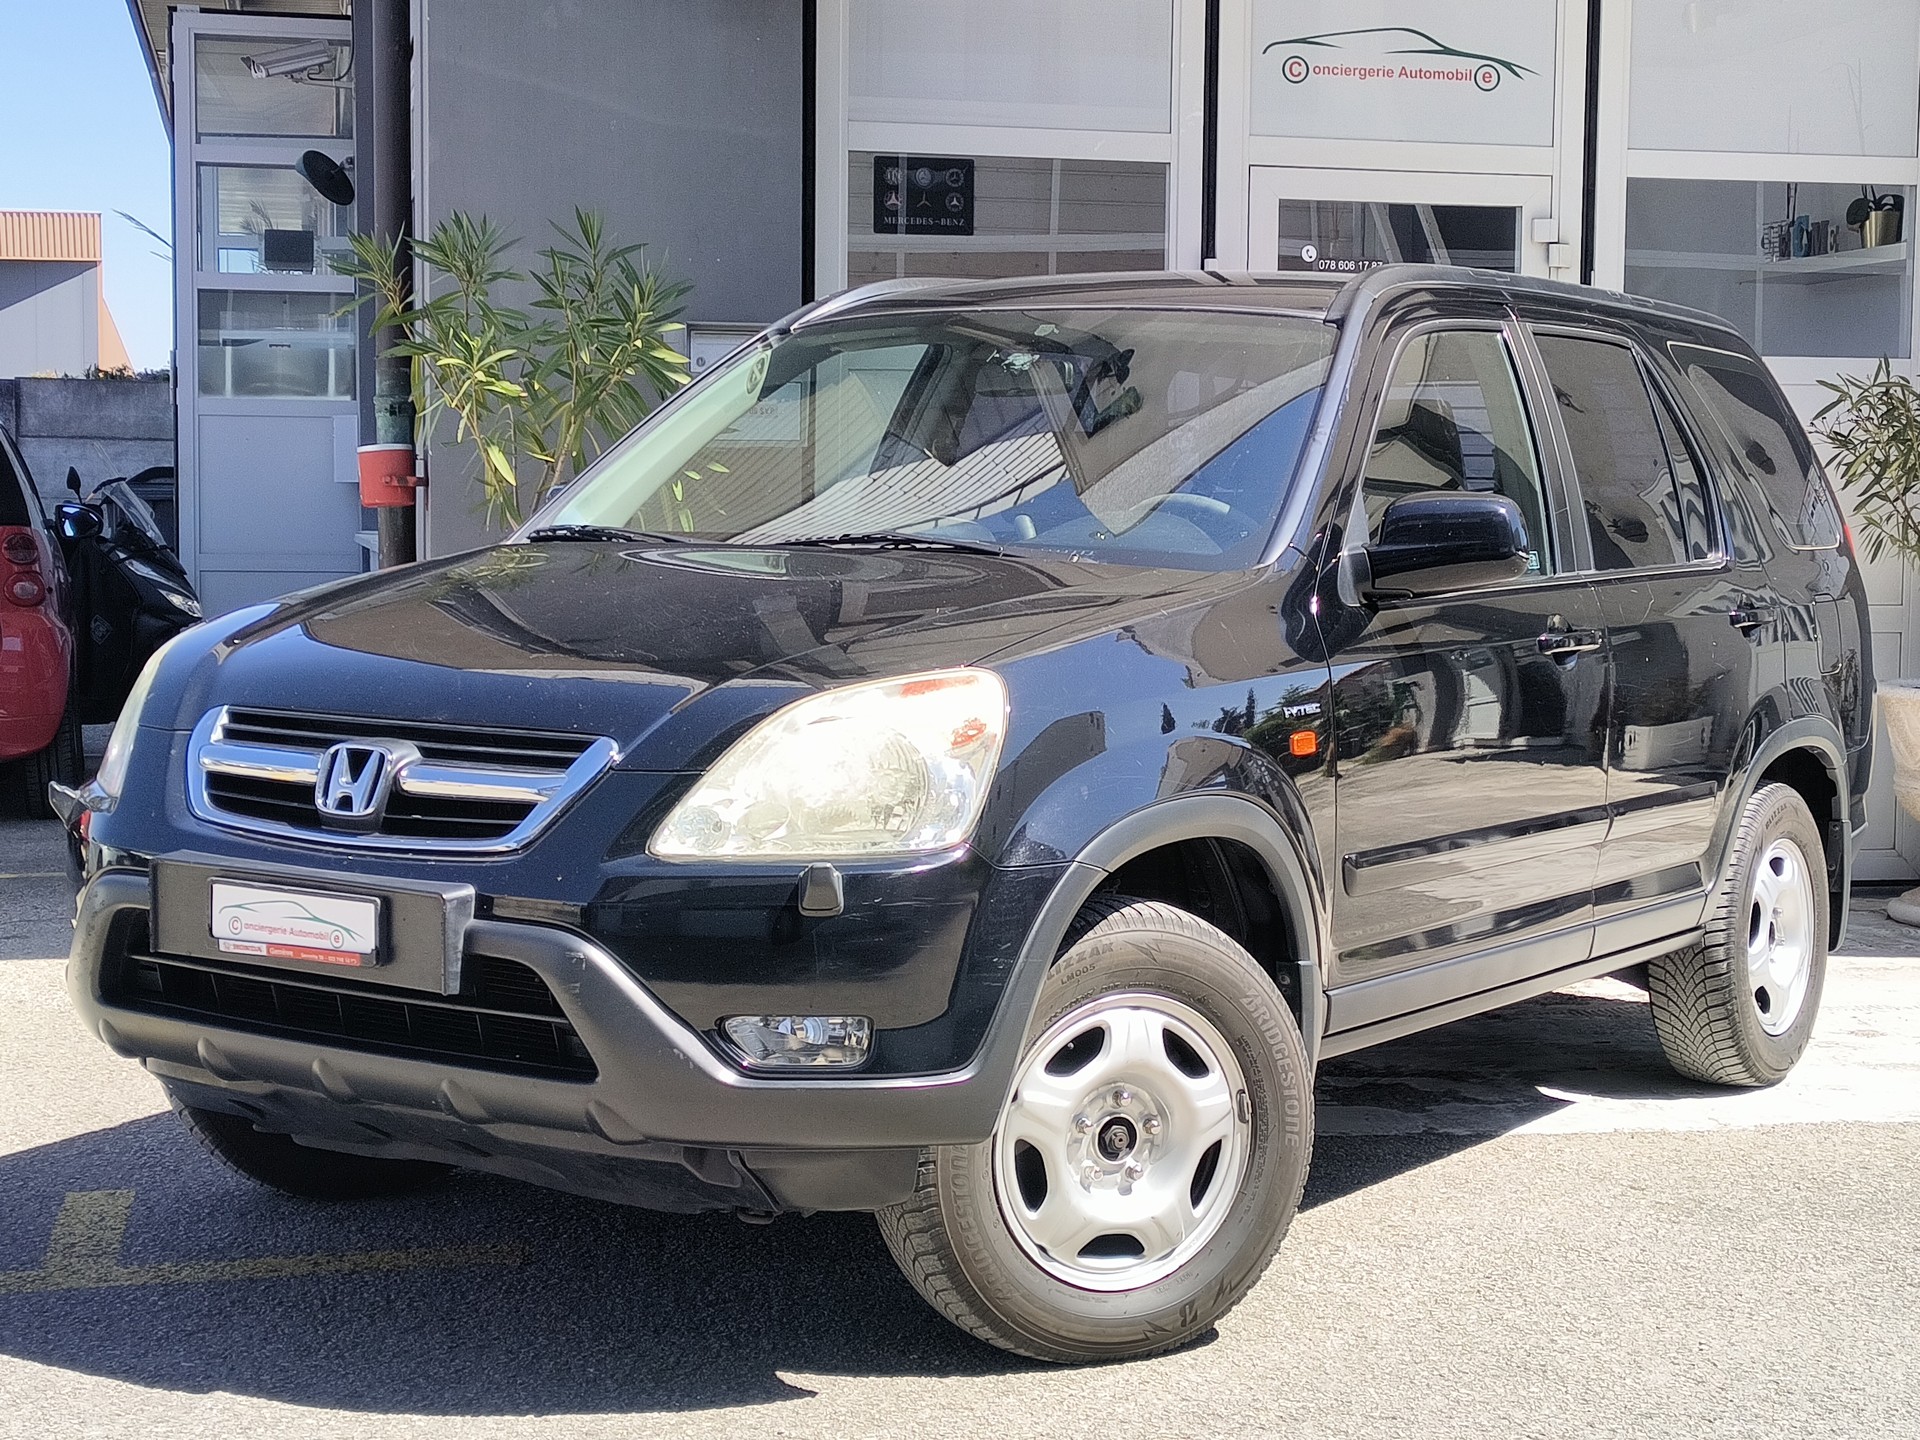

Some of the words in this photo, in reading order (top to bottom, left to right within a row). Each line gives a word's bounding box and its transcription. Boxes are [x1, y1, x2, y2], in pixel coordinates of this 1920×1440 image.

[884, 216, 965, 226] MERCEDES-BENZ
[1319, 260, 1336, 270] 078
[1338, 260, 1355, 270] 606
[1358, 261, 1369, 271] 17
[1046, 941, 1115, 982] LIZZAK
[1060, 963, 1096, 985] LM005
[1239, 988, 1300, 1149] BRIDGESTONE
